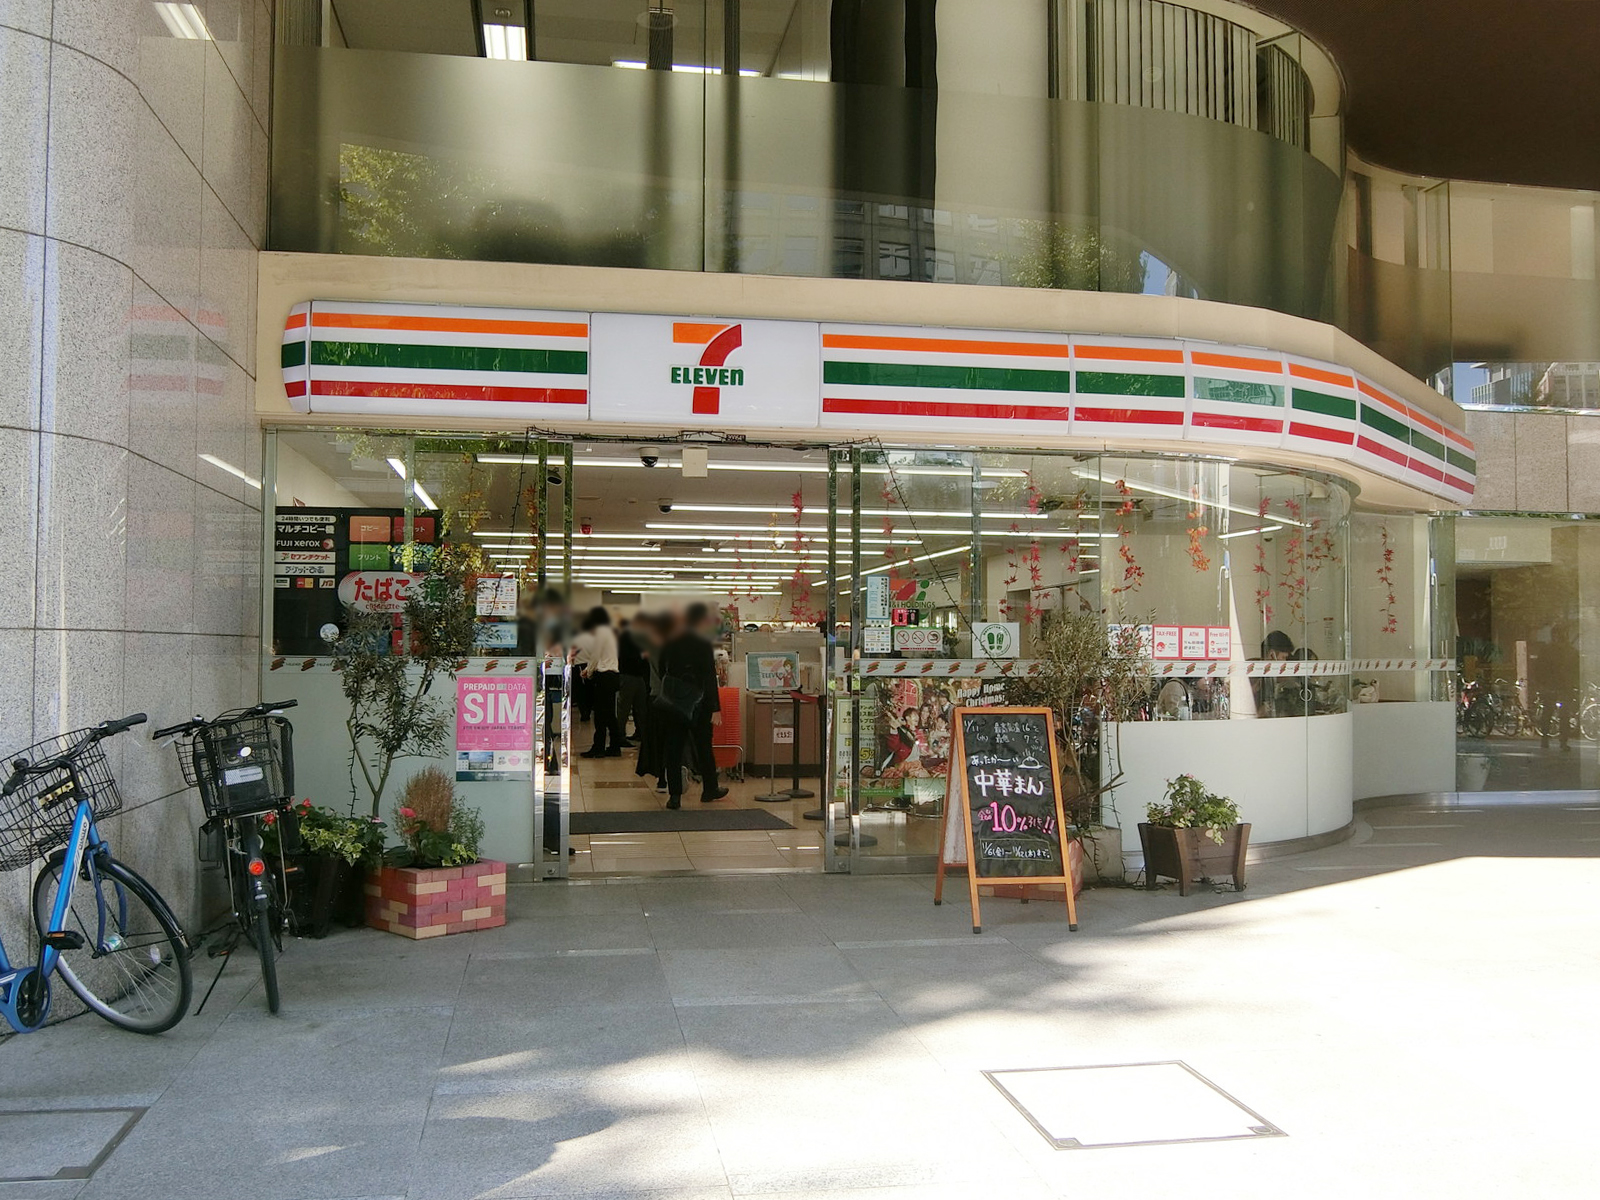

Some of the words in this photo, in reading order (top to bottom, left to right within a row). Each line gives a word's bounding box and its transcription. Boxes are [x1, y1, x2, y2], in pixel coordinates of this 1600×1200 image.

[354, 577, 410, 601] たばこ
[957, 687, 981, 698] Happy
[463, 692, 527, 724] SIM
[974, 768, 1044, 797] 中華まん
